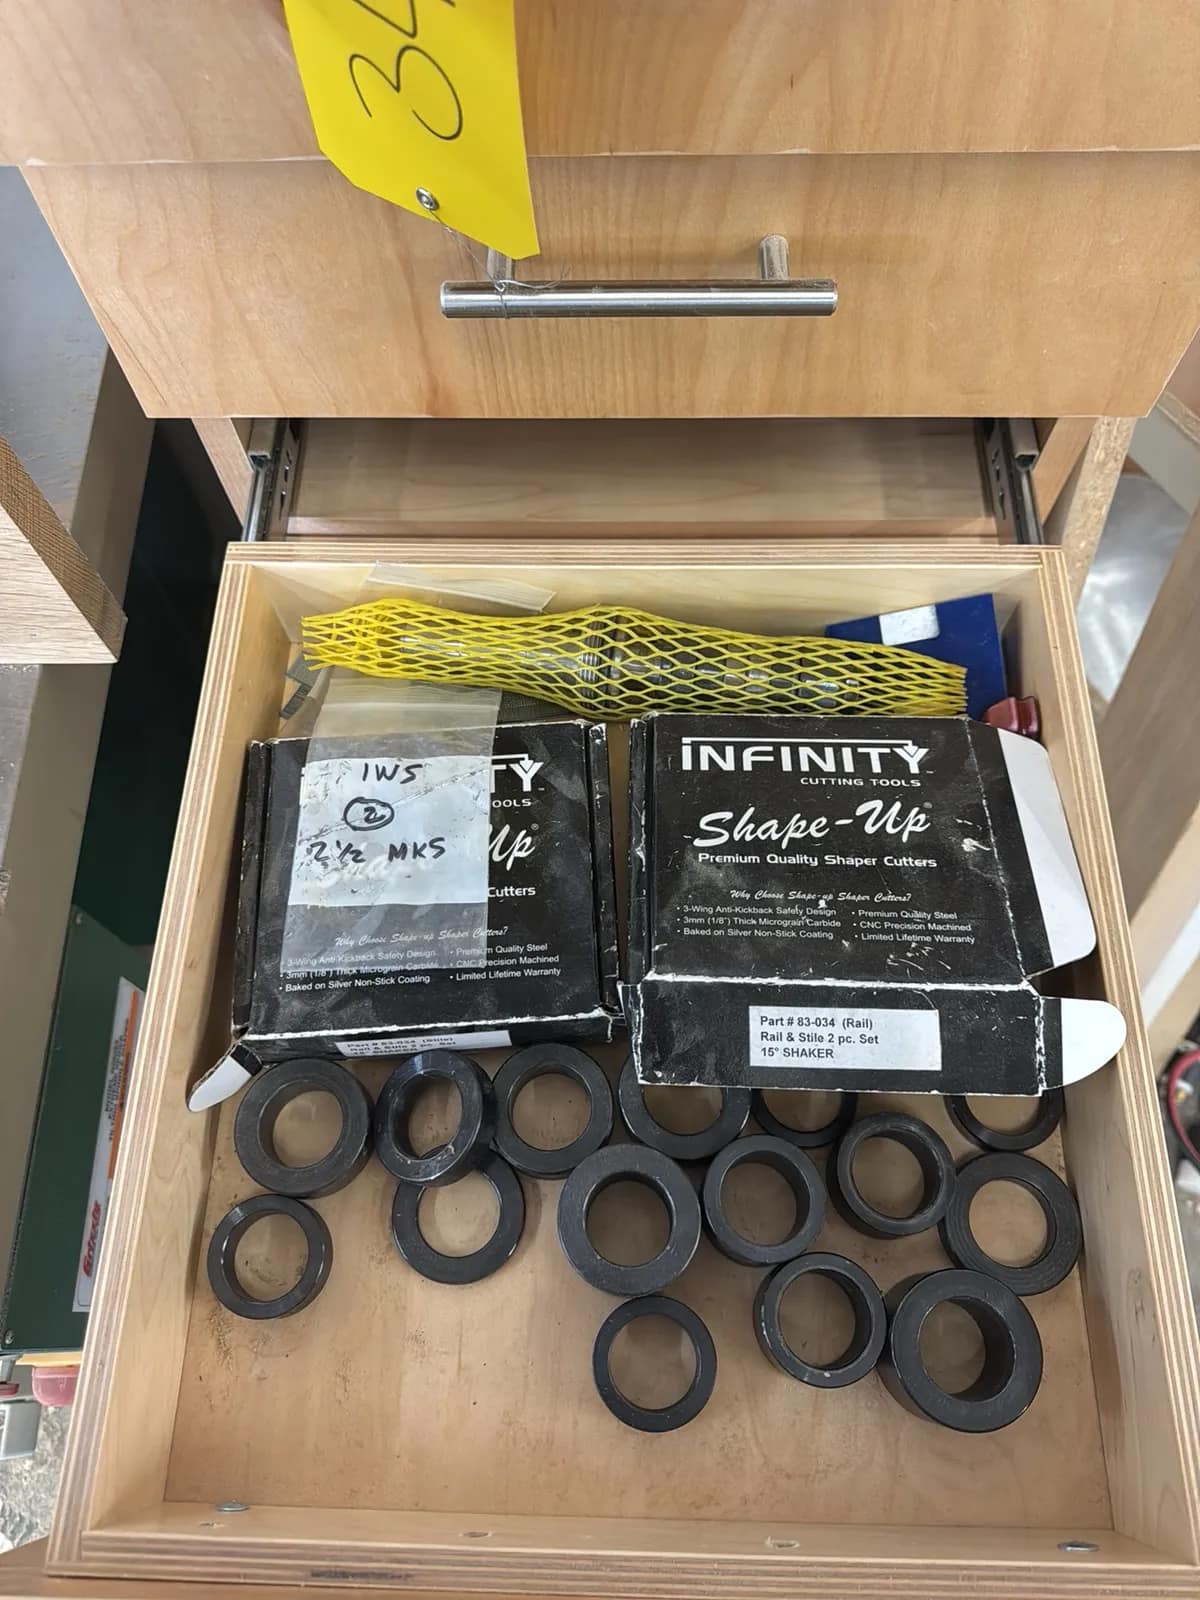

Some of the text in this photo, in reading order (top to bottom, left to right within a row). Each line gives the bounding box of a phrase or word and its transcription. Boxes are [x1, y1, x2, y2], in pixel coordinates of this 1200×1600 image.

[681, 738, 930, 774] INFINITY
[800, 777, 921, 787] CUTTING TOOLS
[492, 798, 532, 808] OOLS
[693, 800, 931, 850] Shape-Up
[698, 853, 937, 868] Premium Quality Shaper Cutters
[488, 886, 536, 897] Cutters
[730, 890, 750, 900] Why
[754, 890, 784, 900] Choose
[837, 892, 870, 902] Shaper
[874, 893, 912, 903] Cutters?
[683, 905, 836, 916] 3-Wing Anti-Kickback Safety Design
[858, 909, 957, 920] Premium Quality Steel
[683, 917, 705, 925] 3mm
[734, 917, 757, 925] Thick
[759, 918, 805, 927] Micrograin
[806, 919, 841, 927] Carbide
[860, 920, 972, 931] CNC Precision Machined
[683, 928, 711, 936] Baked
[727, 928, 752, 937] Silver
[754, 929, 797, 938] Non-Stick
[799, 930, 834, 940] Coating
[861, 933, 976, 945] Limited Lifetime Warranty
[456, 943, 548, 956] Premium Quality Steel
[519, 955, 559, 964] Machined
[456, 967, 561, 981] Limited Lifetime Warranty
[285, 974, 430, 992] Baked on Silver Non-Stick Coating
[760, 1016, 873, 1030] Part # 83-034 (Rail)
[760, 1031, 879, 1045] Rail & Stile 2 pc. Set
[761, 1047, 834, 1059] 15° SHAKER
